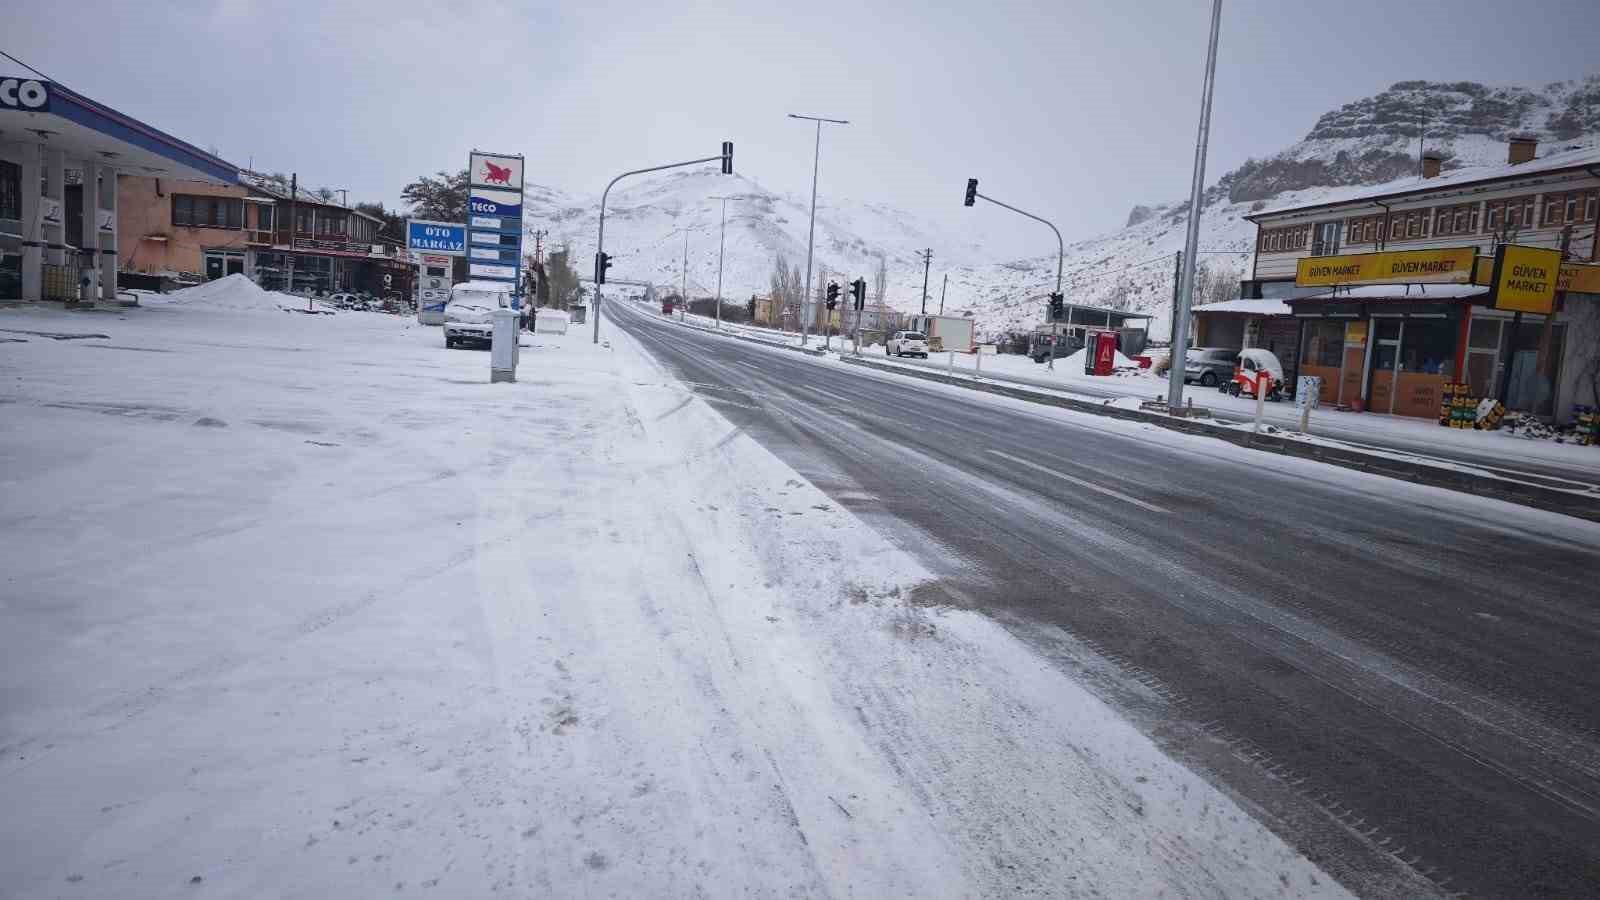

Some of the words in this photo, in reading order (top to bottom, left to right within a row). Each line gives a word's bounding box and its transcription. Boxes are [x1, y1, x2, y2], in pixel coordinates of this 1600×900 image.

[472, 202, 497, 213] TECO
[425, 226, 451, 238] OTO
[411, 238, 463, 251] MARGAZ
[1332, 264, 1360, 276] MARKET
[1392, 260, 1419, 274] GÜVEN
[1420, 259, 1457, 272] MARKET
[1512, 264, 1547, 279] GÜVEN
[1507, 279, 1548, 293] MARKET
